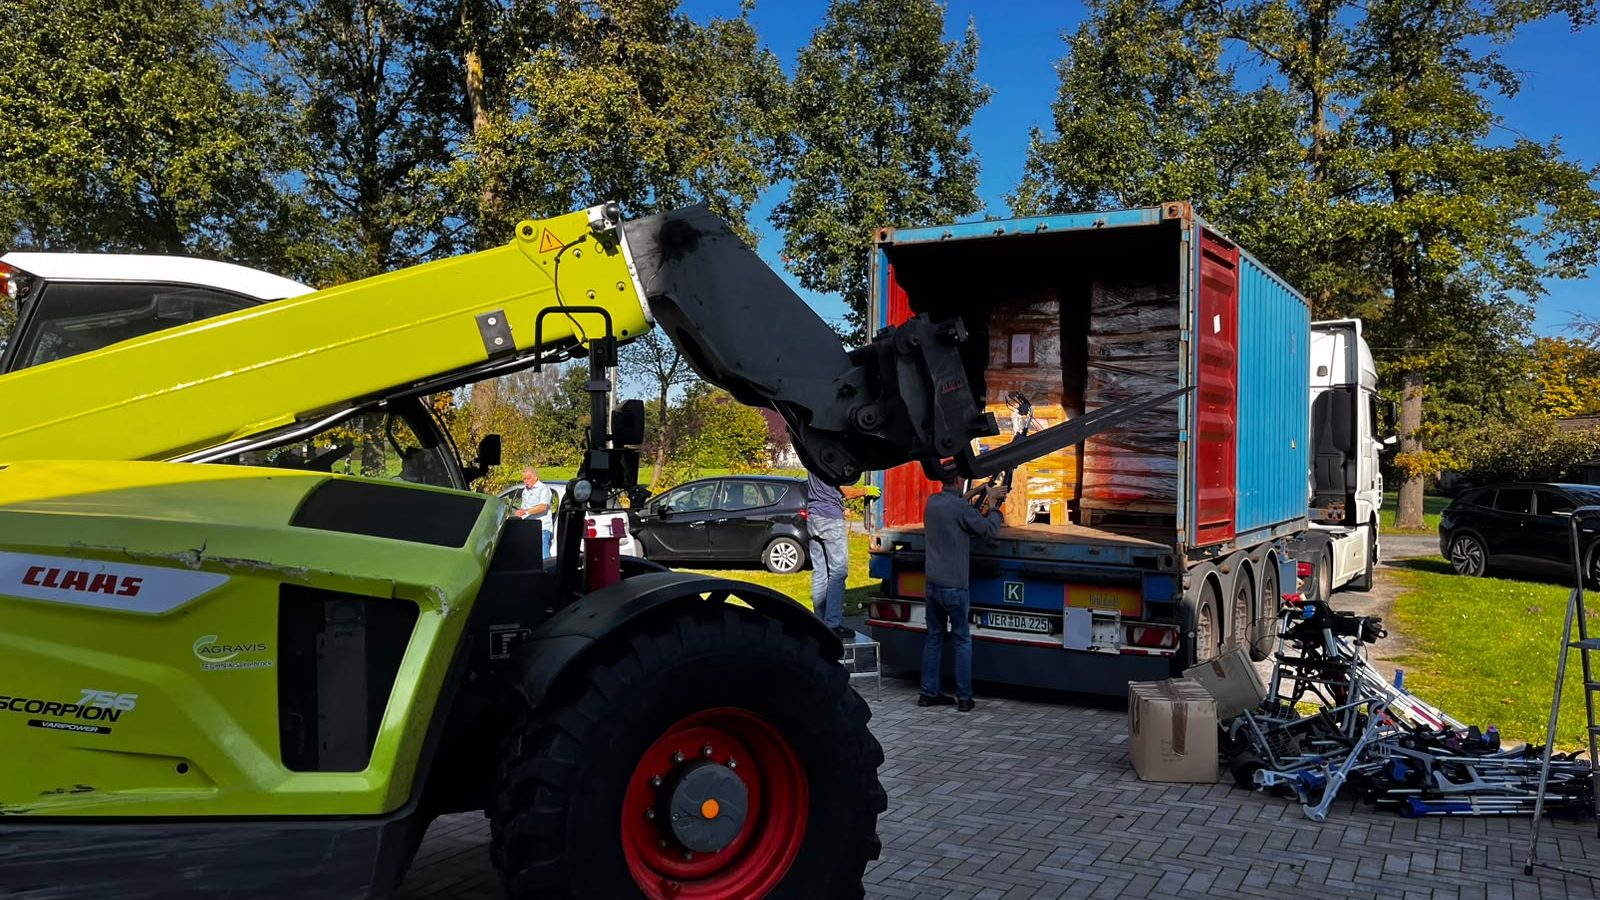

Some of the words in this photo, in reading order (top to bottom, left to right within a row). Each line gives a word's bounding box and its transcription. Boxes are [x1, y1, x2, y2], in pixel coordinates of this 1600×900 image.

[21, 566, 144, 597] CLAAS
[1008, 584, 1019, 600] K
[988, 612, 1007, 627] VER
[1014, 616, 1026, 628] DA
[1029, 617, 1047, 630] 225
[201, 643, 267, 654] AGRAVIS
[76, 688, 139, 710] 756
[0, 695, 121, 722] SCORPION
[42, 721, 98, 732] VARIPOWER
